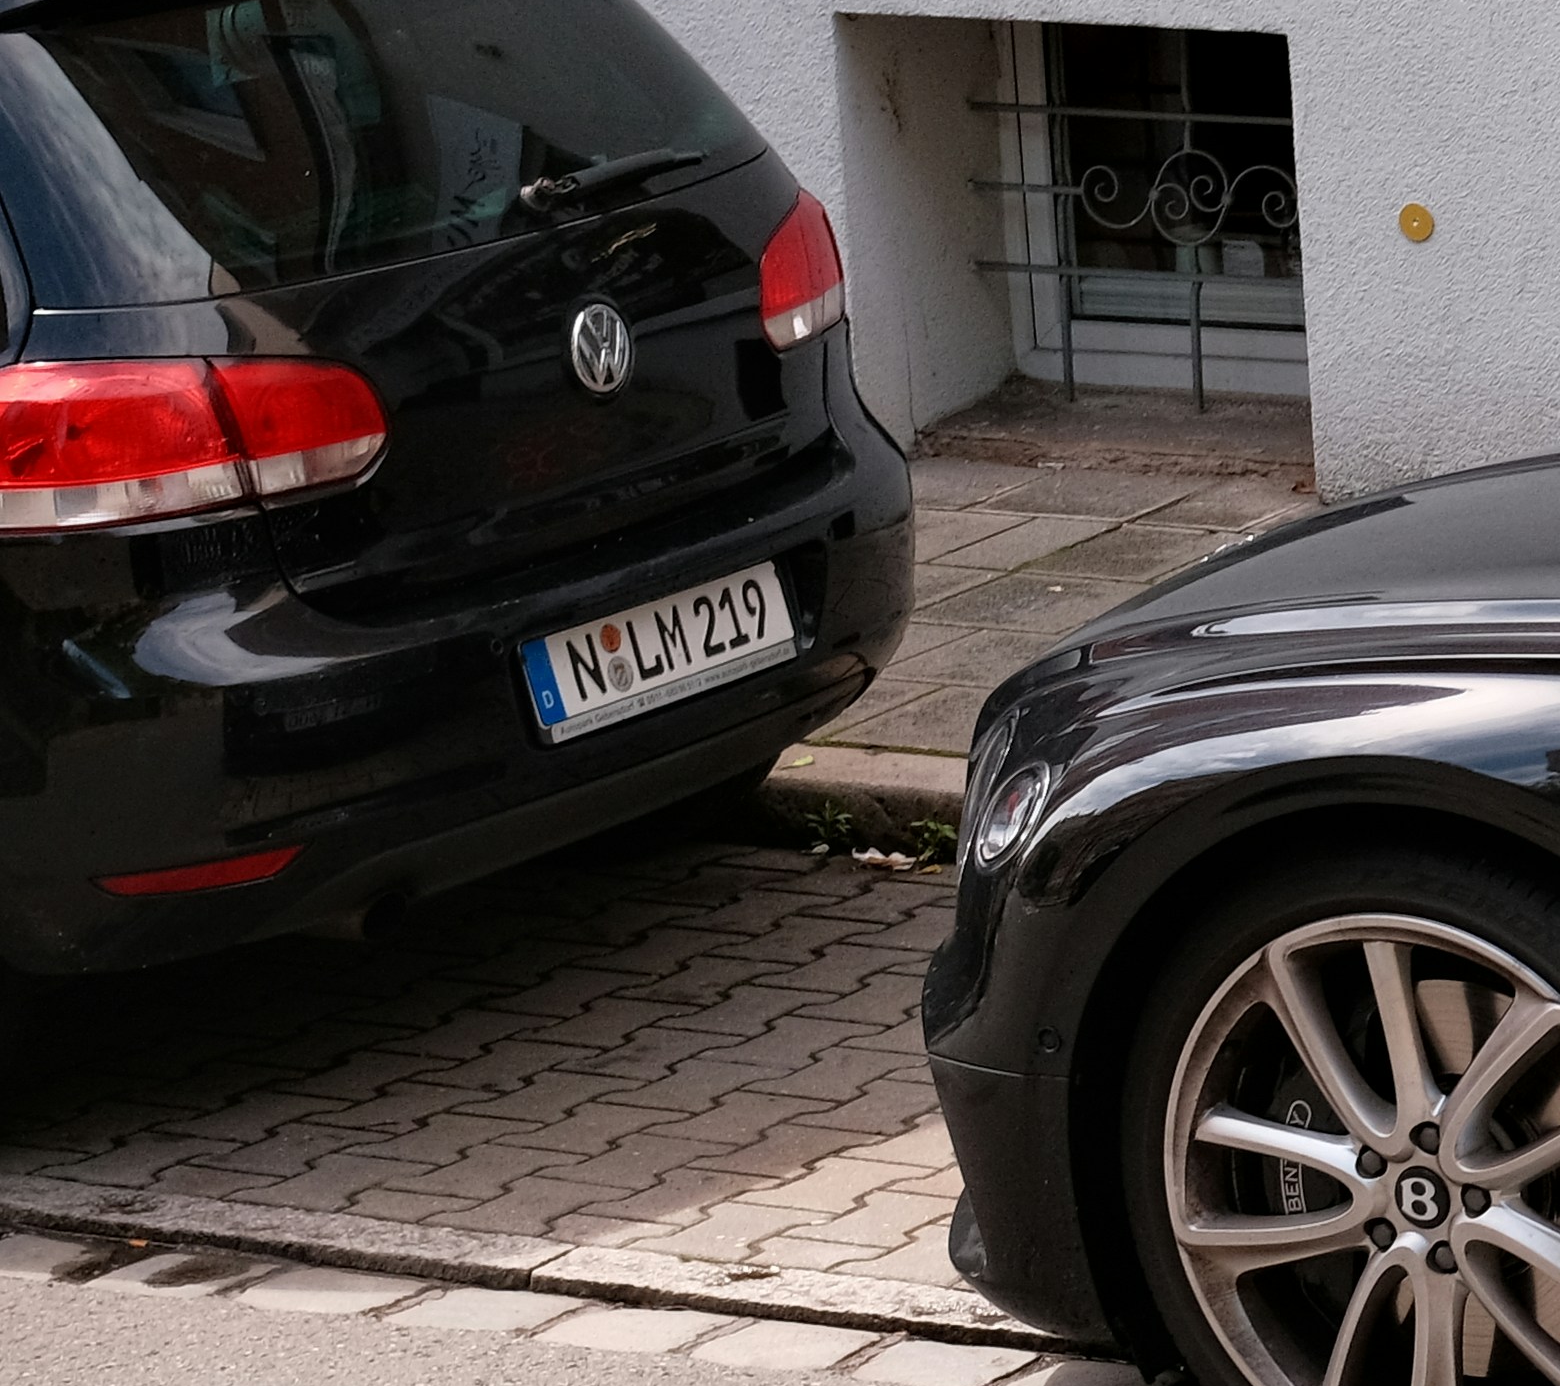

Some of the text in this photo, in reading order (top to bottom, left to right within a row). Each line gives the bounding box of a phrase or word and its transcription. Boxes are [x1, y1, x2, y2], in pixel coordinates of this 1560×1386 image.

[565, 578, 767, 702] N LM 219
[540, 688, 555, 710] D
[1400, 1176, 1440, 1222] B
